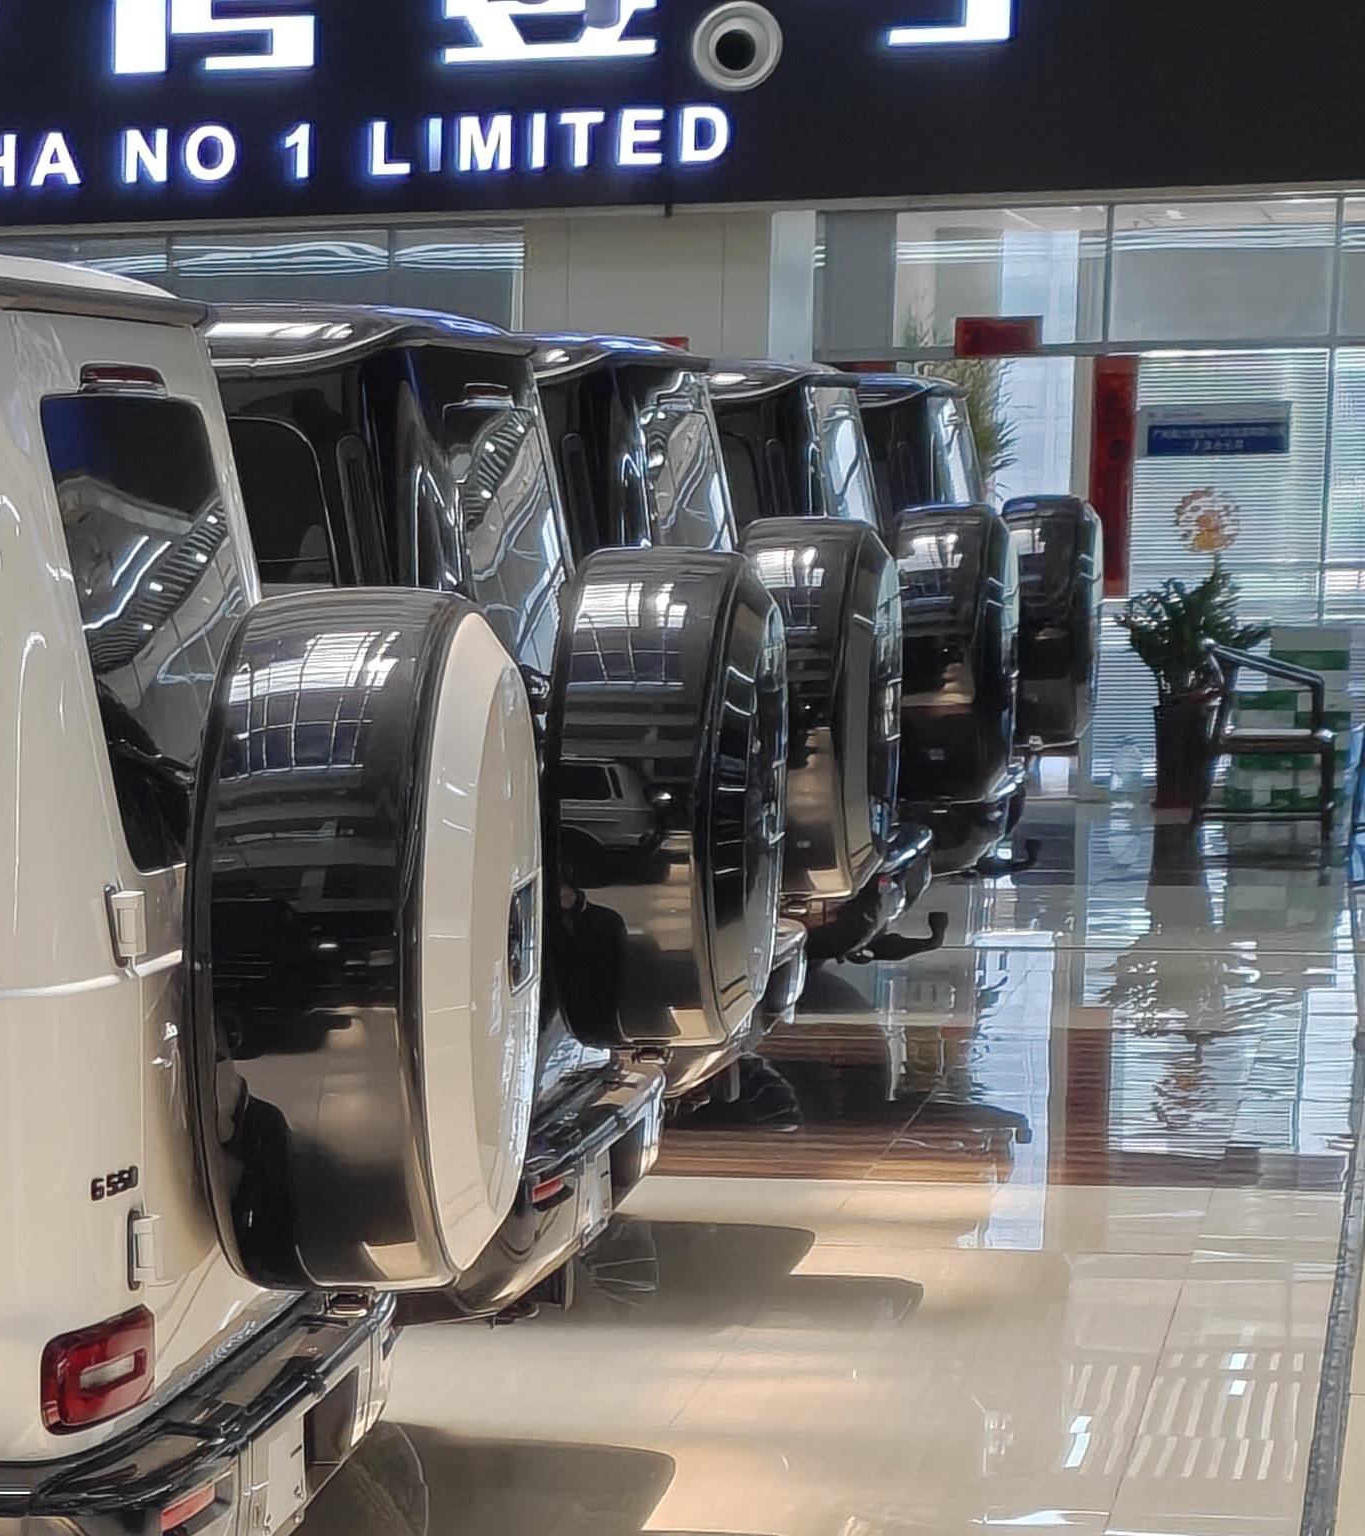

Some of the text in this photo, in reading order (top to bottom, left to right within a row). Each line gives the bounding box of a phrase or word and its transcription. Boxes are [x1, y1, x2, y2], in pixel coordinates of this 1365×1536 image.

[124, 123, 236, 185] NO
[284, 121, 310, 179] 1
[370, 105, 730, 177] LIMITED
